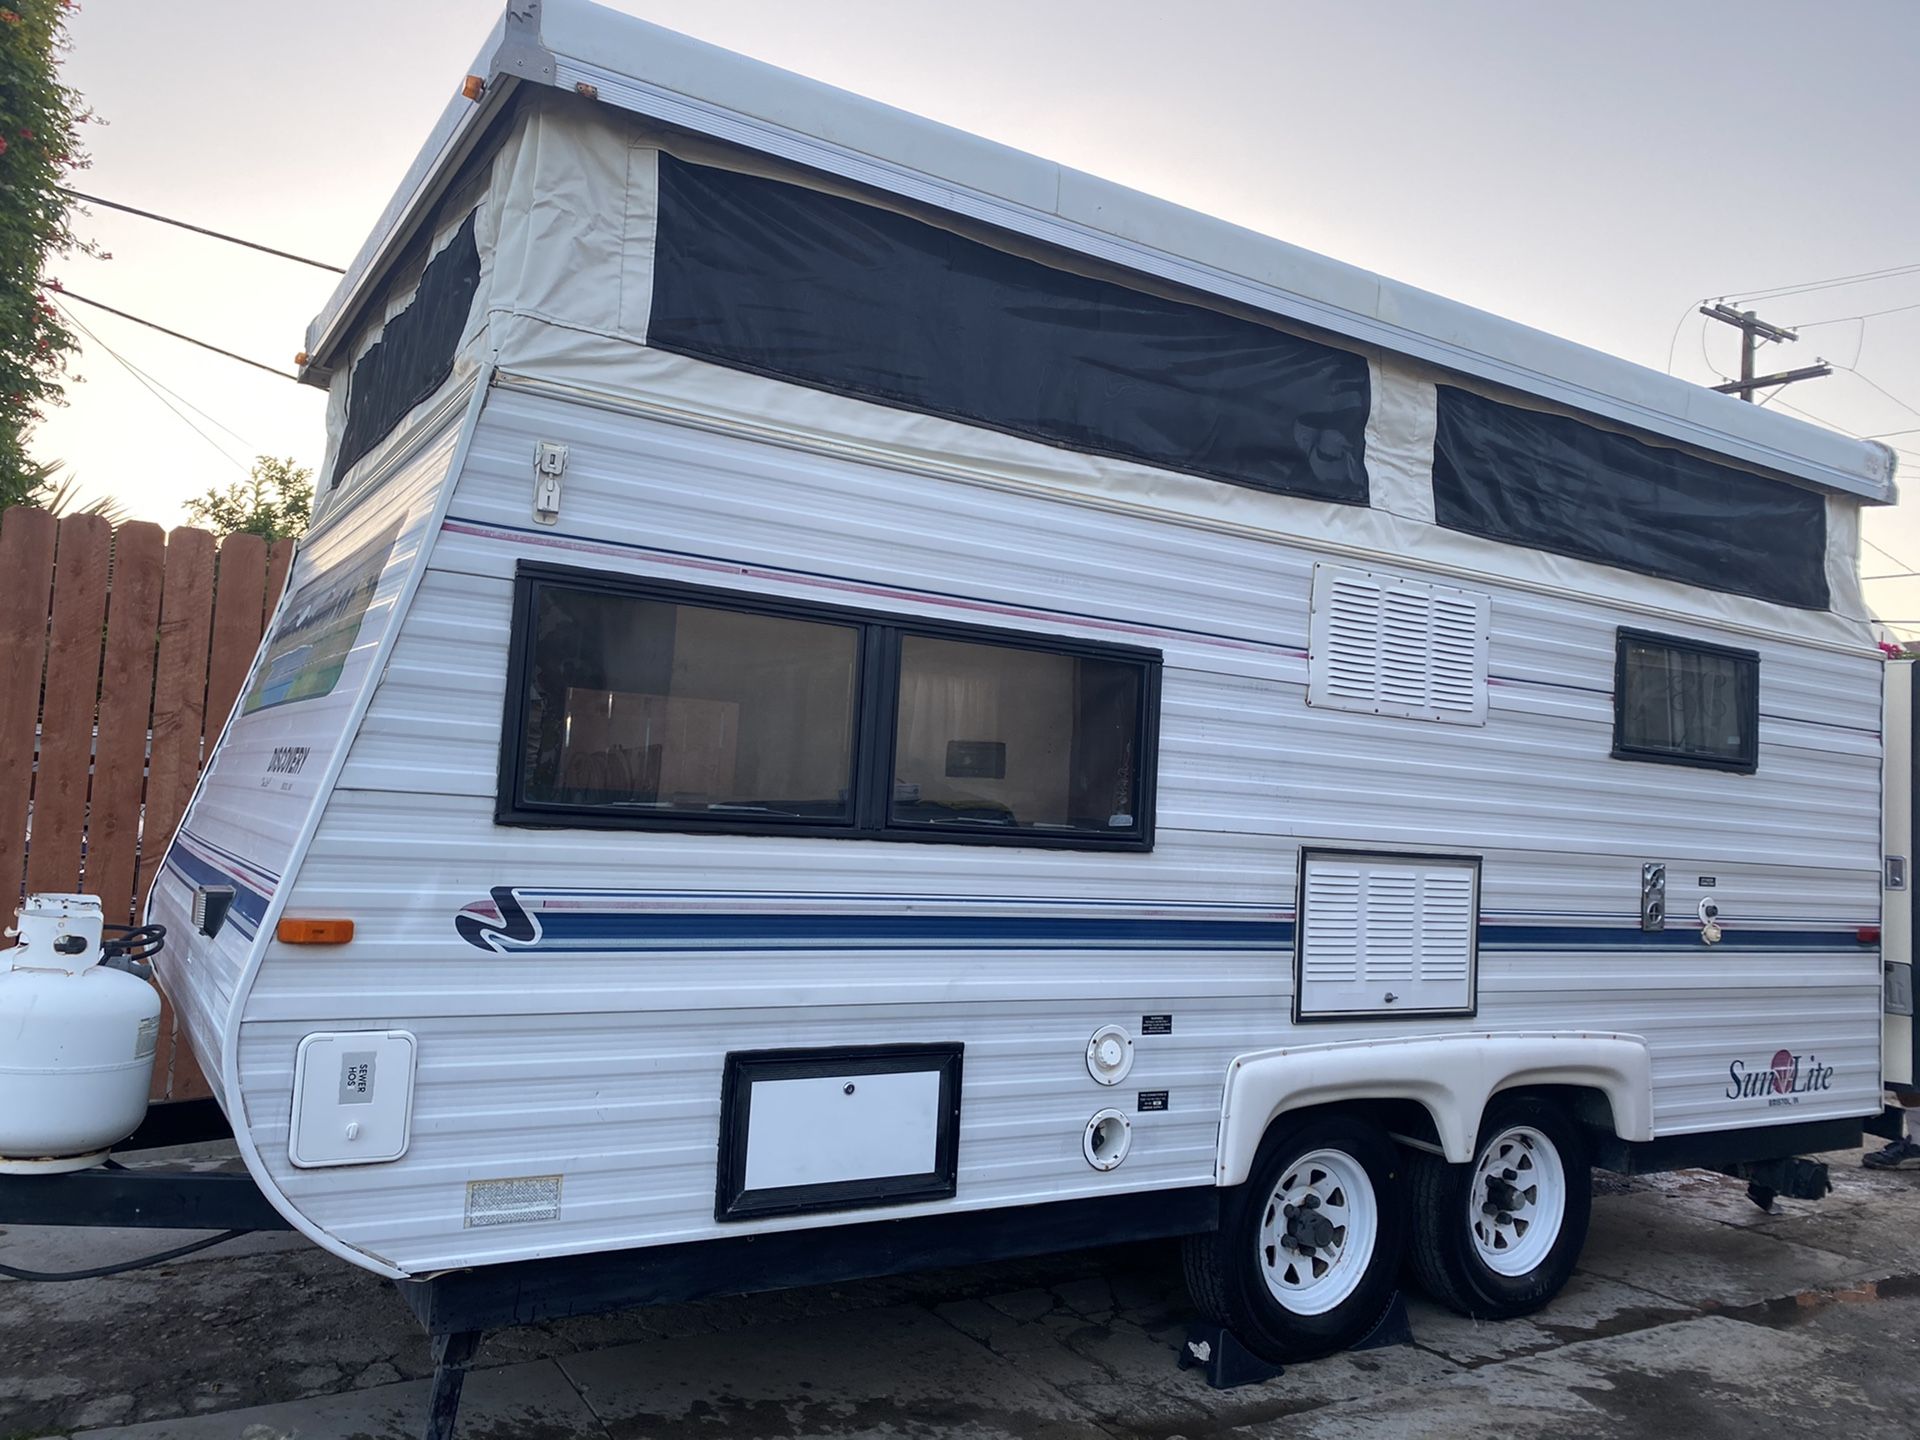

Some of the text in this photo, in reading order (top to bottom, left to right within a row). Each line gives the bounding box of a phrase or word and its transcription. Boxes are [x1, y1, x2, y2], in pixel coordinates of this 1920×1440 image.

[267, 746, 311, 775] DISCOVERY
[347, 1066, 358, 1087] HOS
[357, 1063, 369, 1093] SEWER
[1726, 1055, 1834, 1099] Sun Lite
